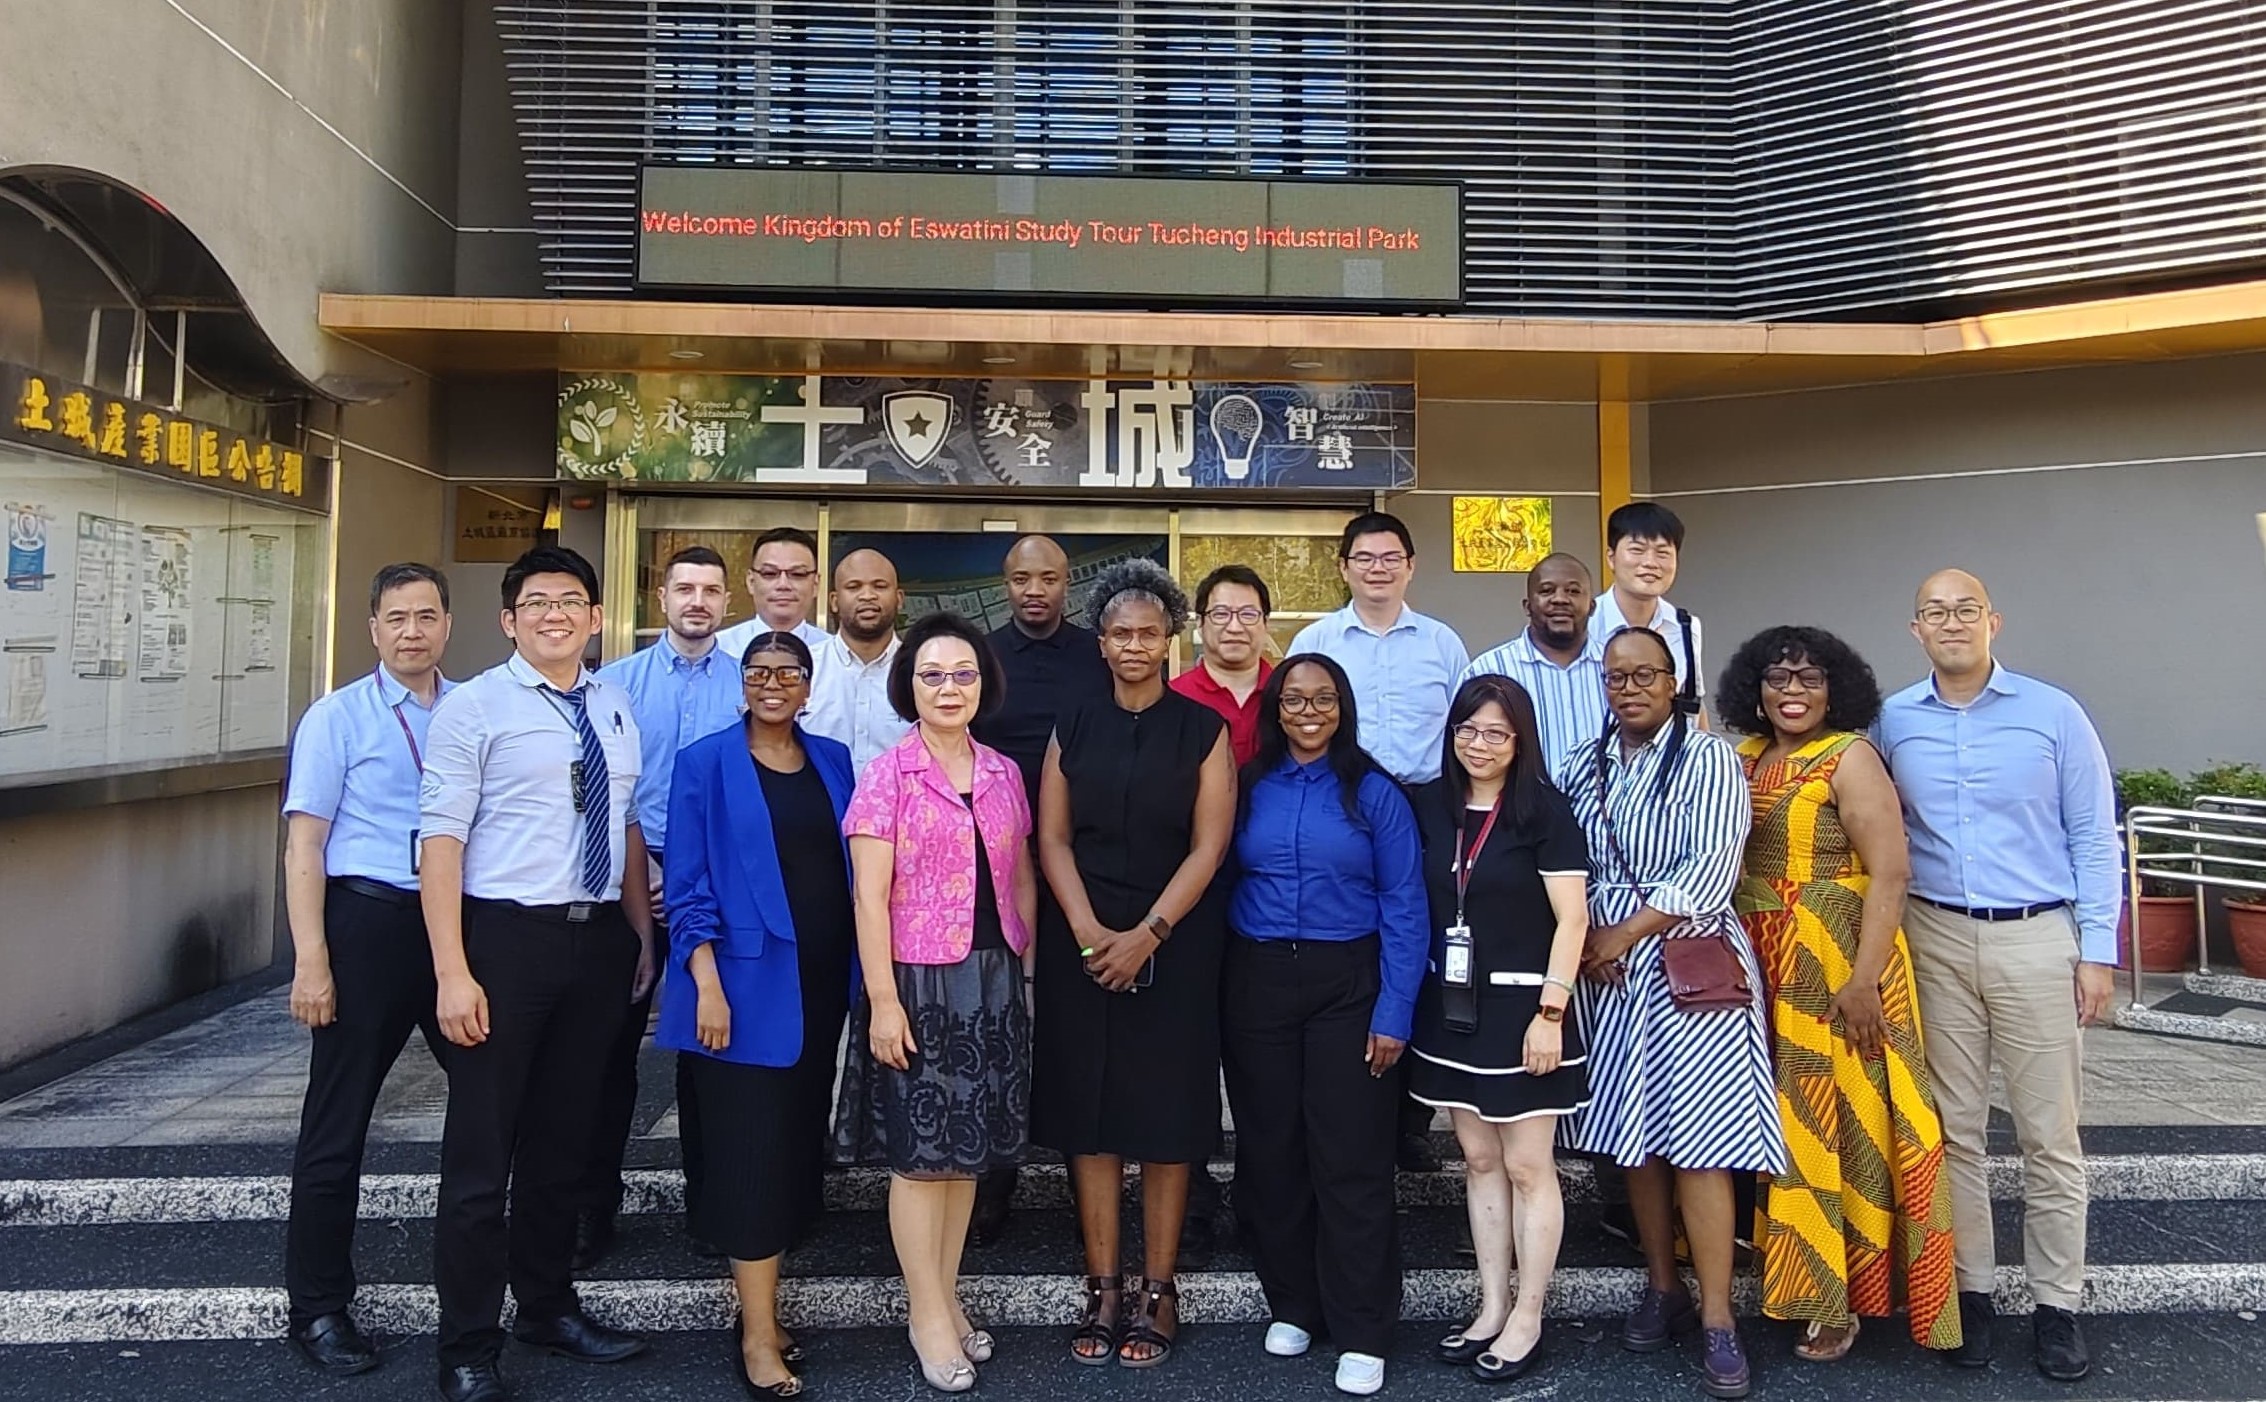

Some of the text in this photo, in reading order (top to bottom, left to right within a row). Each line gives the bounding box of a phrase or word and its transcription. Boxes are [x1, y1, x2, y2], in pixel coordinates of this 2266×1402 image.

[642, 211, 1420, 252] Welcome Kingdom of Eswatini Study Tour Tucheng Industrial Park
[1024, 409, 1052, 419] Guard
[1322, 412, 1351, 421] Create
[1025, 419, 1055, 430] Safety
